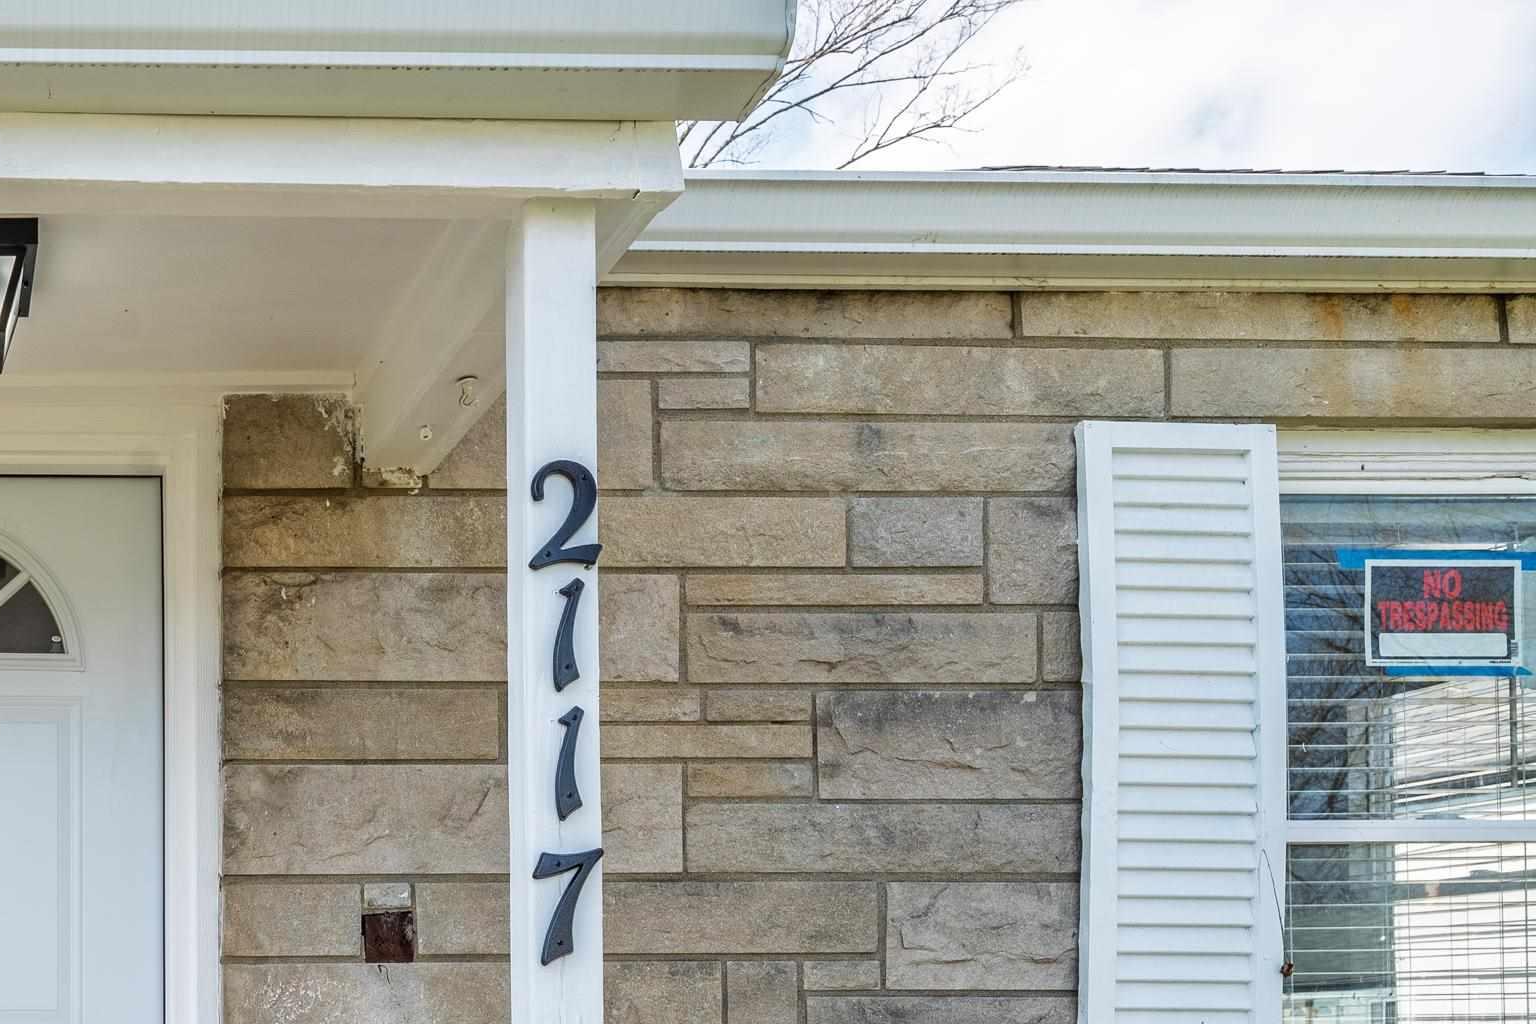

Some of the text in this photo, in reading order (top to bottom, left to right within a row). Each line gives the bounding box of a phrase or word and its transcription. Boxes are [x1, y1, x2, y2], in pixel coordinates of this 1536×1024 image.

[1423, 569, 1462, 599] NO
[1377, 600, 1509, 631] TRESPASSING
[528, 459, 604, 967] 2117
